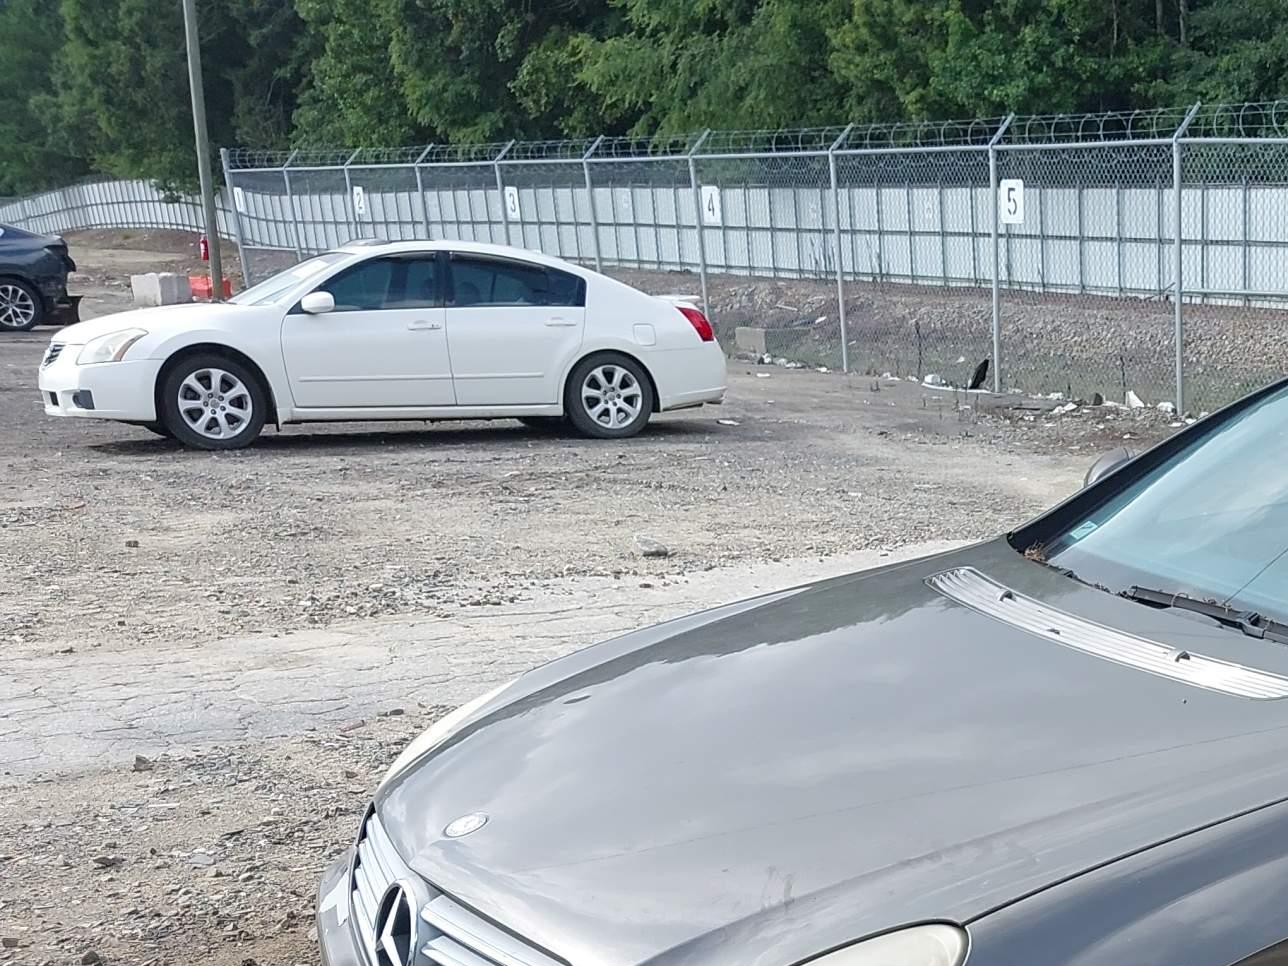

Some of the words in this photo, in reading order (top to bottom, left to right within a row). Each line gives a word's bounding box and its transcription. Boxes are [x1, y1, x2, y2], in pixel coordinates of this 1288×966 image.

[356, 192, 363, 210] 2
[509, 192, 516, 213] 3
[708, 193, 715, 217] 4
[1007, 187, 1018, 215] 5
